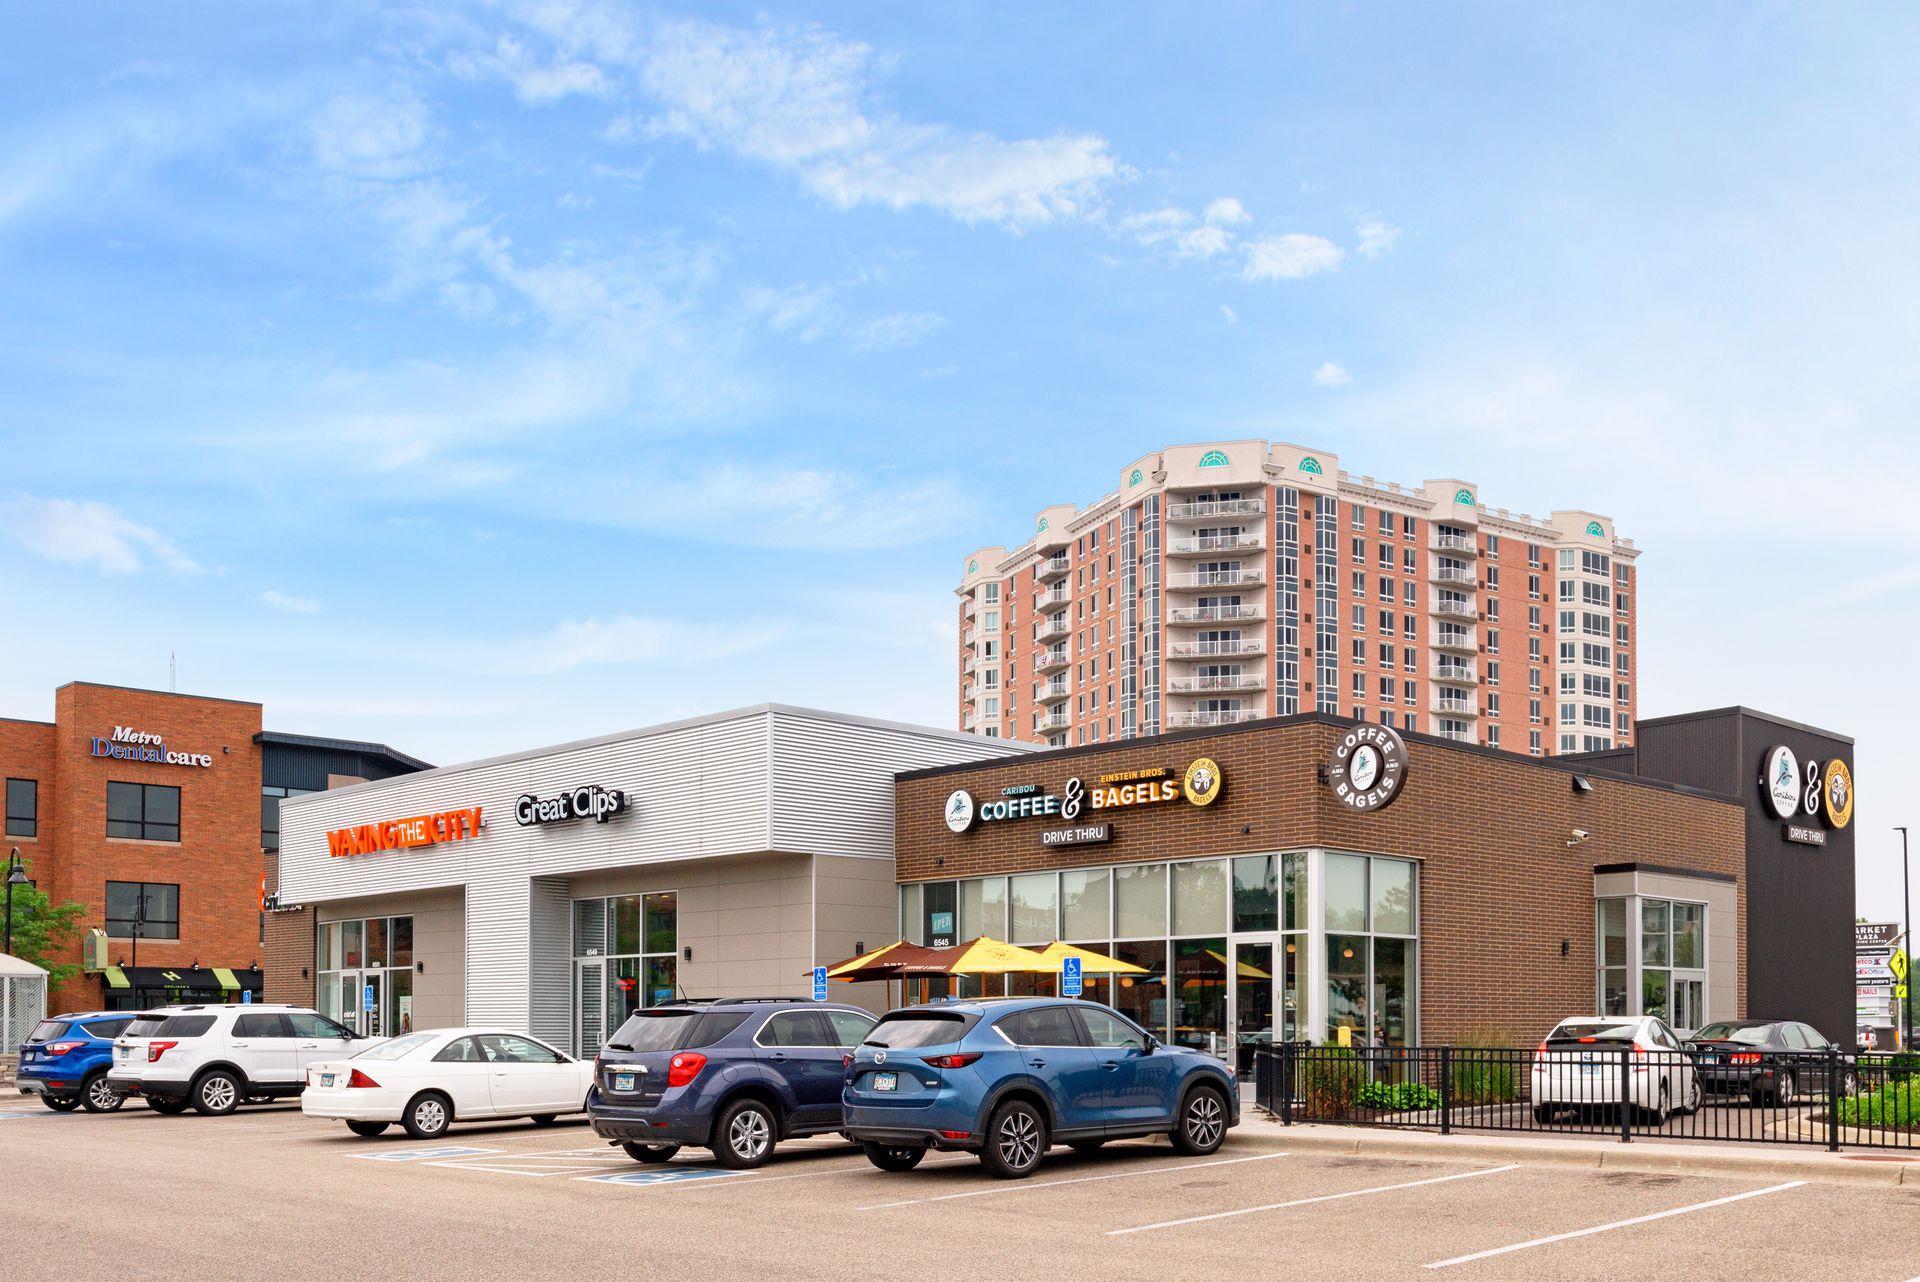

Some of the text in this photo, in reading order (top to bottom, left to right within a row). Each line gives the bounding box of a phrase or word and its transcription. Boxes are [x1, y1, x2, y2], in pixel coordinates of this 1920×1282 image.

[111, 726, 162, 745] Metro
[1337, 728, 1395, 758] COFFEE
[91, 736, 212, 767] Dentalcare
[1101, 768, 1166, 783] EINSTEIN BROS.
[1001, 785, 1035, 796] CARIBOU
[1336, 777, 1394, 808] BAGELS
[1773, 787, 1796, 801] Caribou
[1804, 760, 1822, 815] &
[515, 786, 619, 825] Great Clips
[980, 777, 1176, 821] COFFEE & BAGELS
[326, 806, 483, 858] WAXING THE CITY
[1043, 827, 1104, 844] DRIVE THRU
[1790, 827, 1824, 843] DRIVE THRU
[1855, 926, 1887, 934] ARKET
[933, 938, 949, 947] 6545
[162, 970, 181, 981] H
[1862, 987, 1878, 995] NAILS
